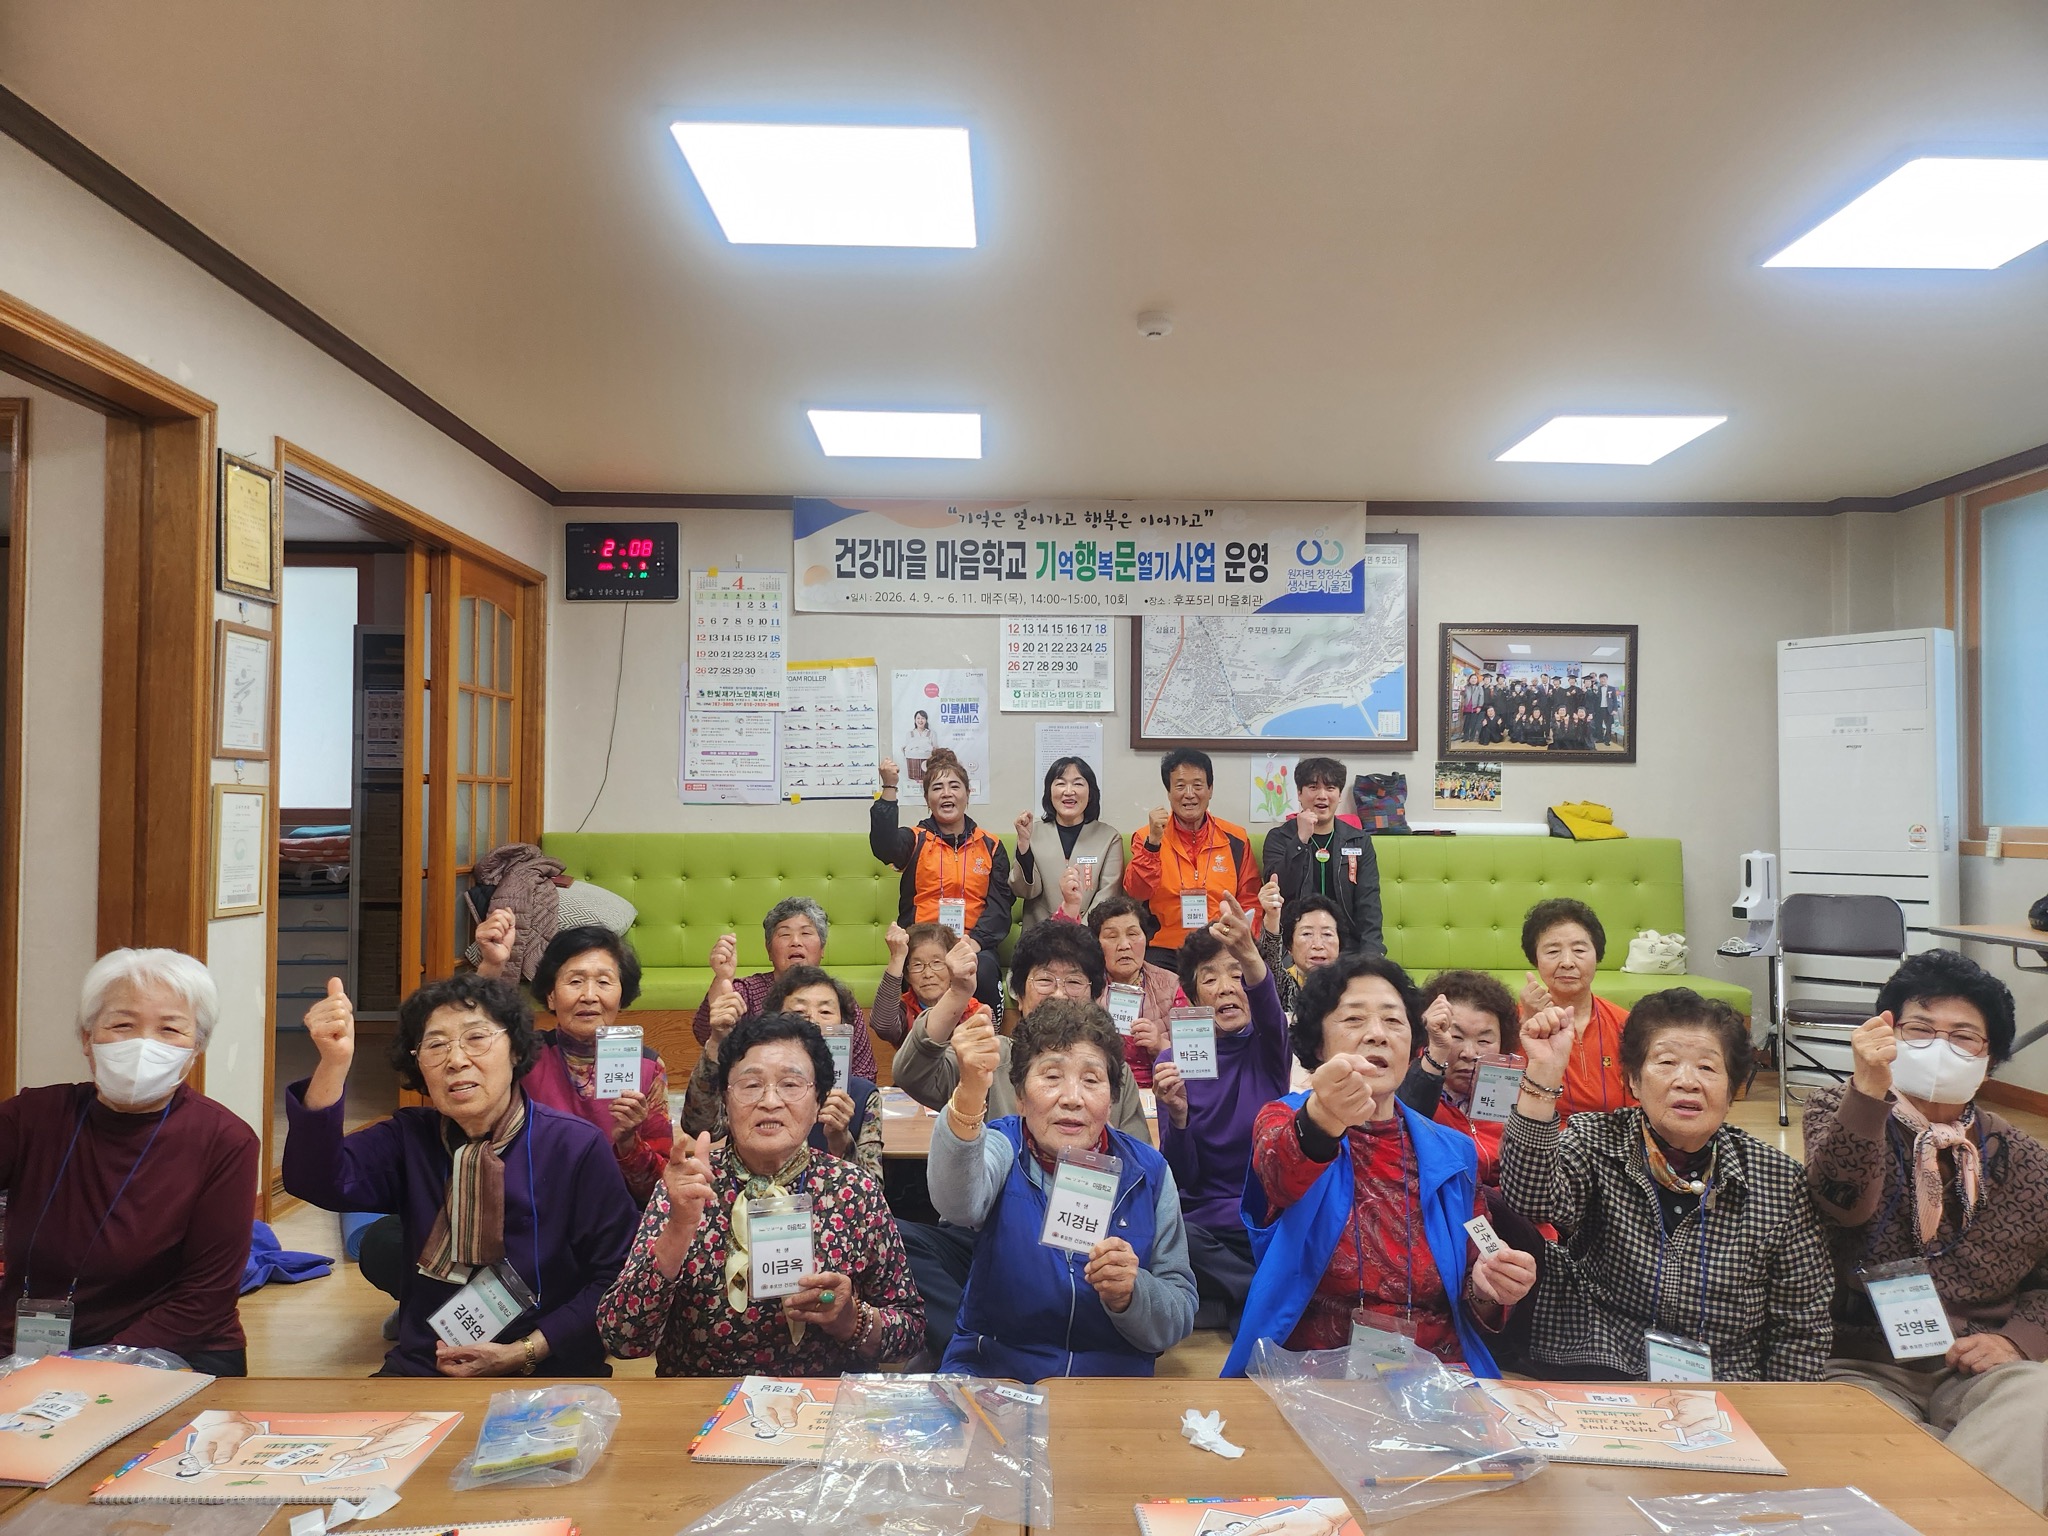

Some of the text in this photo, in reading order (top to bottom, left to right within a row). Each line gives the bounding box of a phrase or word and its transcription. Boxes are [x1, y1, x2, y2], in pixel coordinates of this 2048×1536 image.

[1014, 508, 1077, 530] 열어가고
[1084, 509, 1132, 530] 행복은
[835, 538, 927, 580] 건강마을
[936, 539, 1027, 581] 마음학교
[1224, 541, 1269, 583] 운영
[1374, 556, 1398, 565] 후포5리
[1287, 569, 1352, 580] 원자력 청정수소
[732, 576, 745, 590] 4
[1287, 580, 1351, 592] 생산도시 울진
[875, 591, 906, 603] 2026.
[909, 592, 920, 603] 4.
[923, 592, 933, 603] 9.
[947, 592, 958, 604] 6.
[962, 593, 977, 604] 11.
[1030, 593, 1101, 606] 14:00~15:00,
[1105, 594, 1128, 606] 10회
[1173, 594, 1214, 606] 후포5리
[1217, 594, 1263, 607] 마을회관
[698, 617, 780, 625] 5 6 7 8 9 10 11
[1008, 624, 1107, 634] 12 13 14 15 16 17 18
[696, 634, 780, 642] 12 13 14 15 16 17 18
[1008, 643, 1107, 653] 19 20 21 22 23 24 25
[1008, 661, 1078, 671] 26 27 28 29 30
[706, 690, 780, 699] 한빛재가노인복지센터
[940, 703, 979, 714] 이불세탁
[940, 715, 980, 724] 무료서비스
[1179, 1050, 1209, 1061] 박금숙
[604, 1072, 634, 1084] 김옥선
[1057, 1211, 1100, 1233] 지경남
[762, 1258, 803, 1275] 이금옥
[453, 1303, 486, 1342] 김점연
